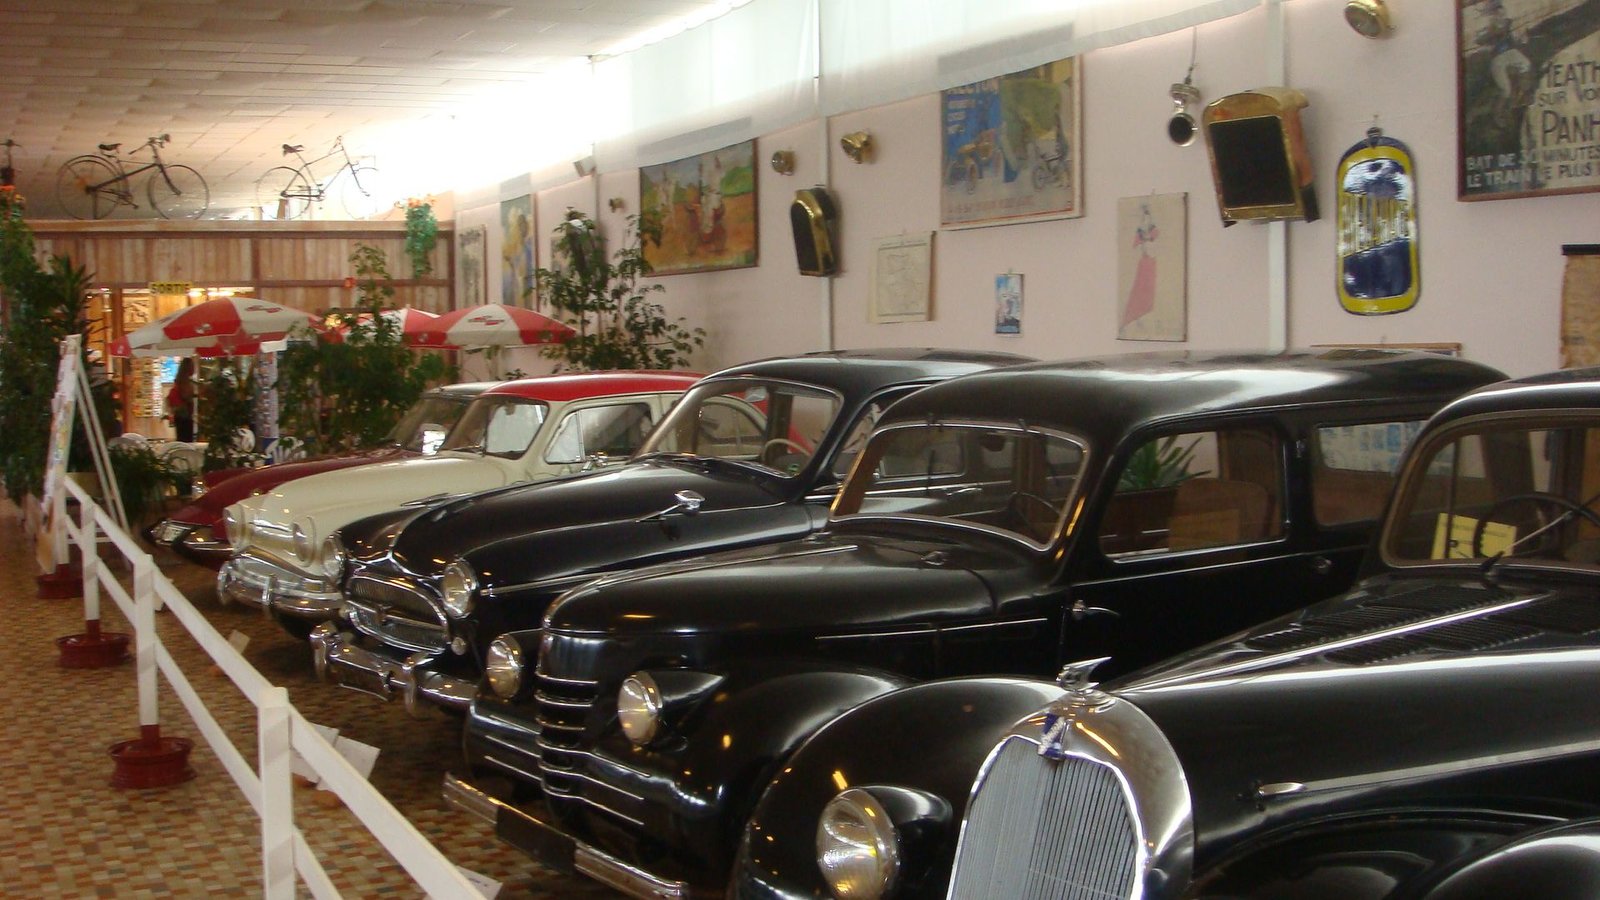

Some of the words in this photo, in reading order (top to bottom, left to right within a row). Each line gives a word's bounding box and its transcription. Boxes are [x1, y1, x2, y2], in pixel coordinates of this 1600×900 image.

[1466, 173, 1482, 188] LE
[1559, 162, 1592, 179] PLUS
[151, 283, 190, 295] SORTIE
